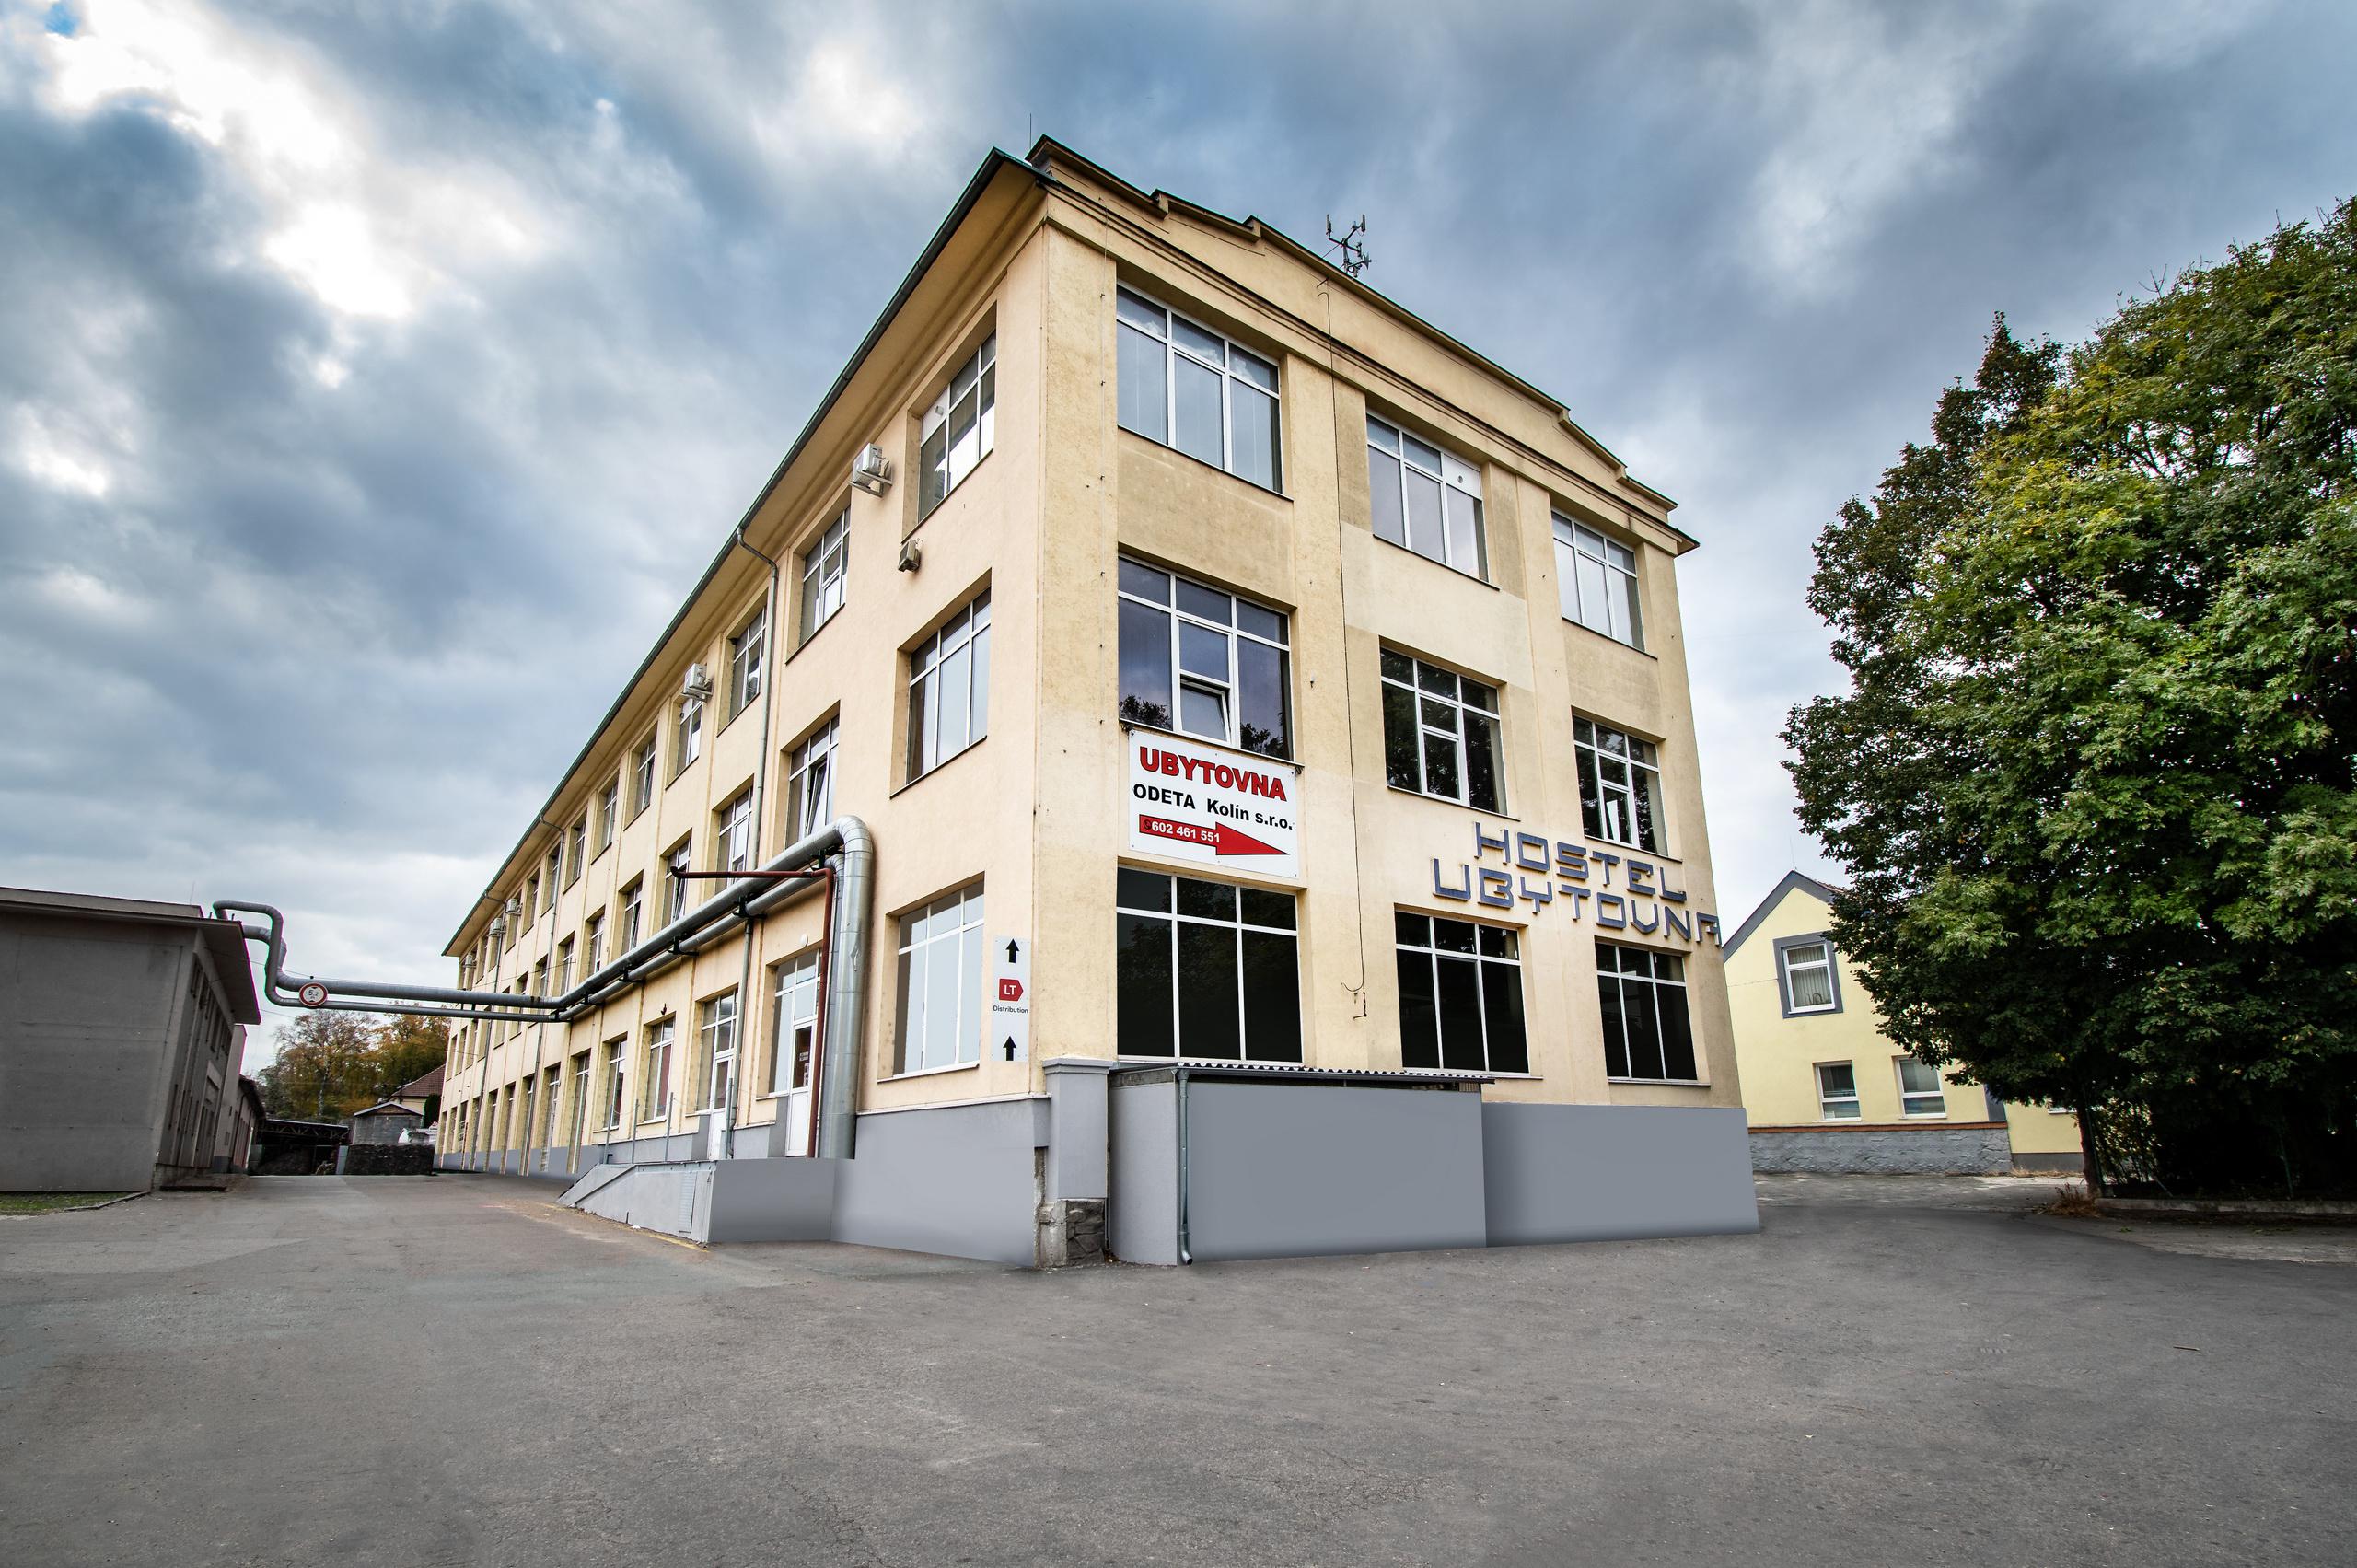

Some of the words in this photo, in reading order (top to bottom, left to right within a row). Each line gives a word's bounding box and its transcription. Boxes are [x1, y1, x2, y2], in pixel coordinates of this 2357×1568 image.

[1140, 746, 1286, 801] UBYTOVNA
[1133, 784, 1195, 809] ODETA
[1207, 798, 1249, 820] Kolín
[1255, 812, 1293, 830] s.r.o.
[1152, 820, 1173, 834] 602
[1176, 826, 1197, 839] 461
[1200, 830, 1220, 843] 551
[1474, 821, 1687, 901] HOSTEL
[1433, 858, 1722, 946] UBYTOVNA
[993, 1005, 1028, 1014] Distribution
[1004, 985, 1016, 995] LT
